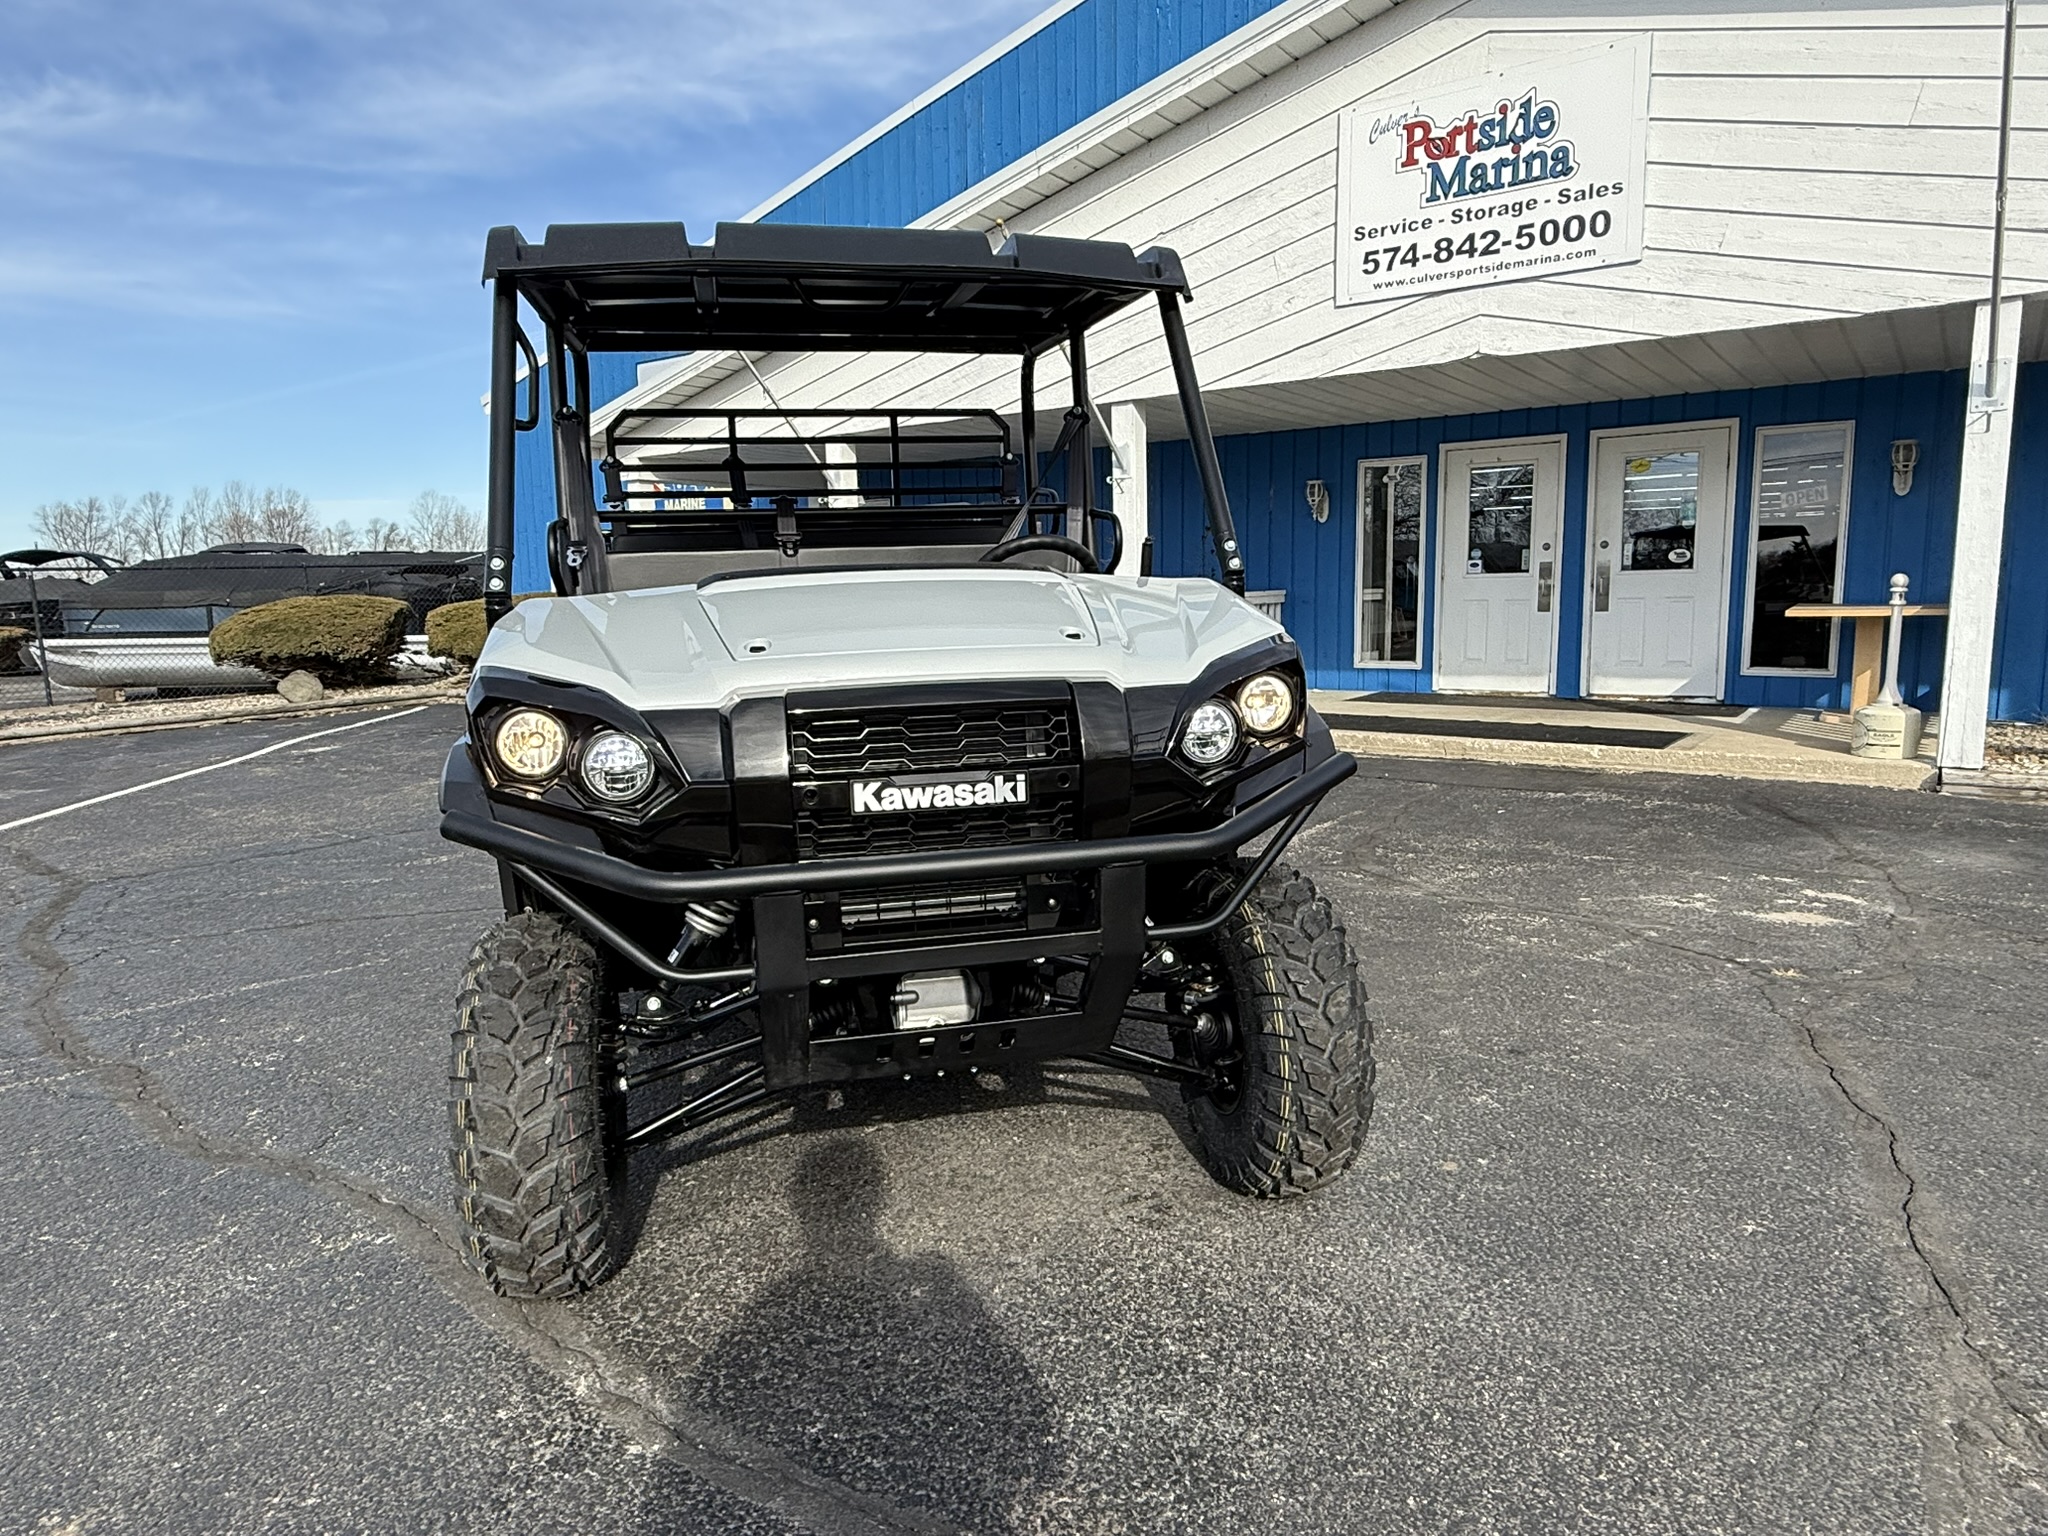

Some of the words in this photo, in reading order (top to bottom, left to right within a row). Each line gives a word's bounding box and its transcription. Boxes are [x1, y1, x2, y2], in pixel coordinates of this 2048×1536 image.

[1369, 100, 1419, 145] Culver's
[1400, 95, 1556, 168] Portside
[1425, 144, 1573, 203] Marina
[1354, 215, 1432, 241] Service
[1450, 198, 1538, 224] Storage
[1557, 181, 1624, 204] Sales
[1362, 209, 1612, 275] 574-842-5000
[1373, 248, 1597, 290] www.culversportsidemarina.com
[664, 499, 706, 510] MARINE
[1785, 487, 1825, 505] OPEN
[853, 774, 1026, 812] Kawasaki
